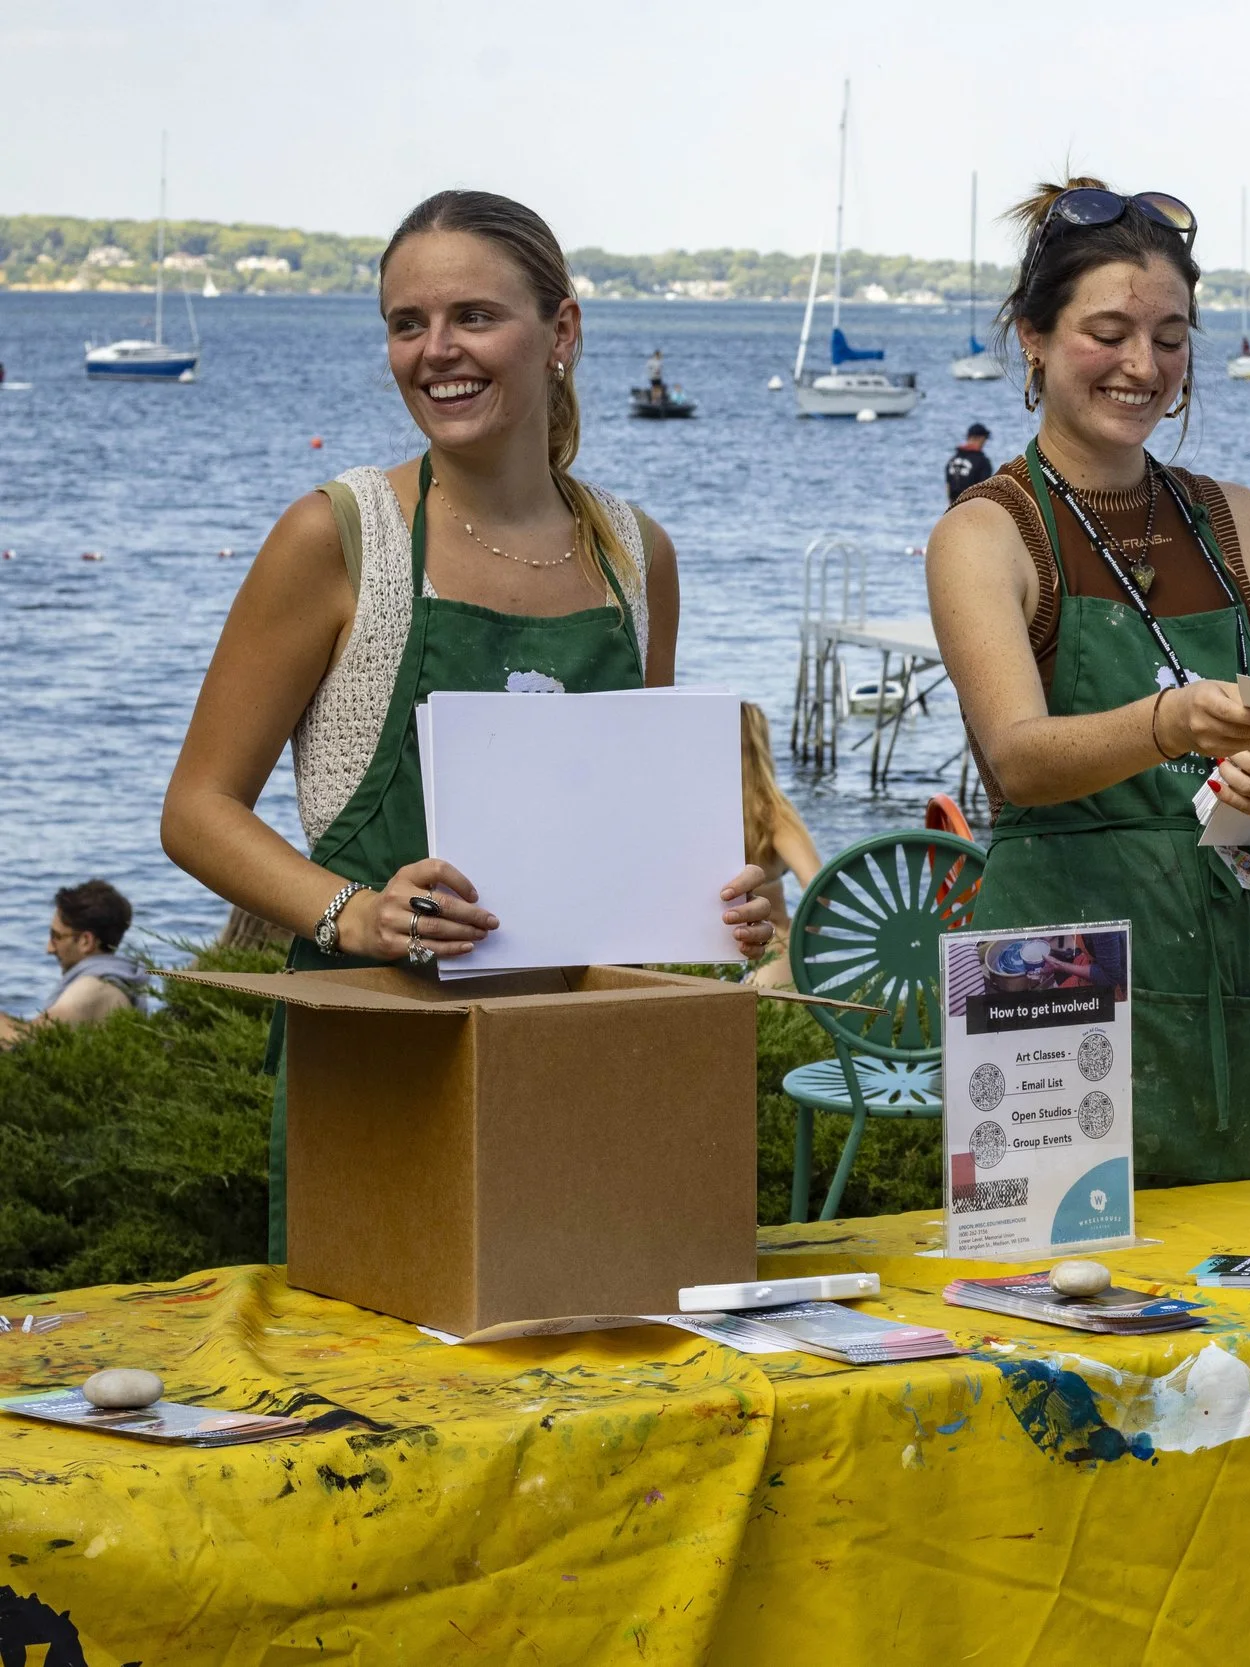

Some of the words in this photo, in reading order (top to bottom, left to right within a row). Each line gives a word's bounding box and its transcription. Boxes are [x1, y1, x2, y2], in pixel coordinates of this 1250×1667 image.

[1064, 493, 1086, 521] Wisconsin
[1084, 520, 1098, 539] Union
[1102, 548, 1125, 578] Experiences
[1121, 576, 1130, 586] for
[1130, 590, 1147, 612] Lifetime
[1151, 621, 1172, 652] Wisconsin
[1168, 651, 1181, 670] Union
[989, 1007, 1015, 1020] How
[1016, 1005, 1028, 1017] to
[1031, 1003, 1050, 1019] get
[1052, 998, 1100, 1015] involved!
[1015, 1053, 1031, 1063] Art
[1033, 1049, 1066, 1061] Classes
[1021, 1079, 1046, 1091] Email
[1047, 1077, 1063, 1089] List
[1011, 1110, 1037, 1123] Open
[1039, 1106, 1072, 1119] Studios
[1013, 1136, 1041, 1149] Group
[1043, 1134, 1072, 1145] Events
[1094, 1195, 1103, 1205] W
[1079, 1215, 1121, 1226] WHEELHOUSE
